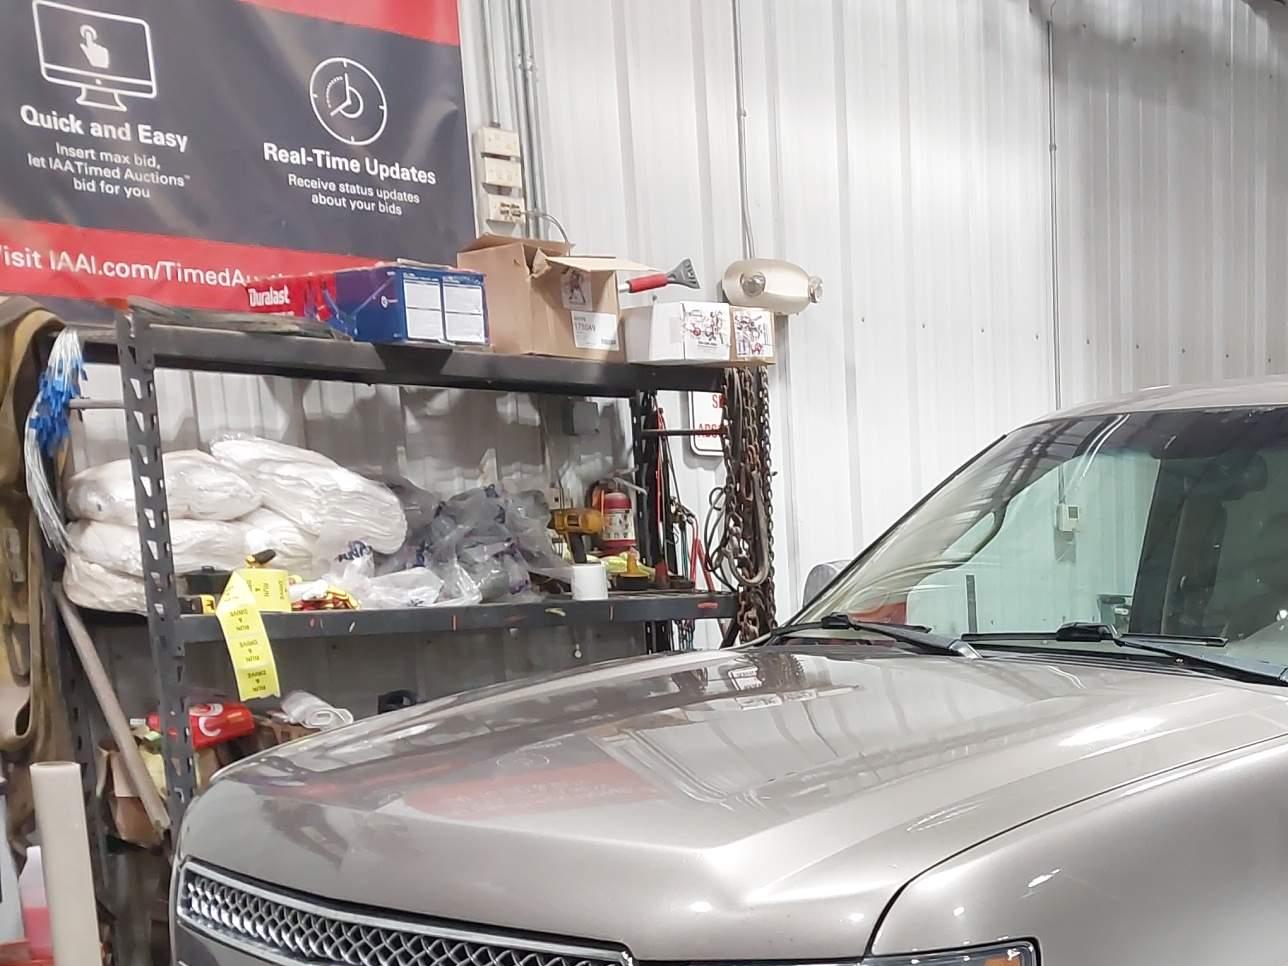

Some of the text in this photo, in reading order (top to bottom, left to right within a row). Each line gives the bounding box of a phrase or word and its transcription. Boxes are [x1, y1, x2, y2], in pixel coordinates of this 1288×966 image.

[20, 104, 189, 154] Quick and Easy
[27, 153, 46, 169] let
[56, 142, 162, 171] Insert max bid,
[263, 142, 437, 186] Real-Time Updates
[73, 177, 151, 199] bid for you
[288, 173, 421, 205] Receive status updates
[311, 193, 403, 216] about your bids
[248, 284, 290, 308] Duralast
